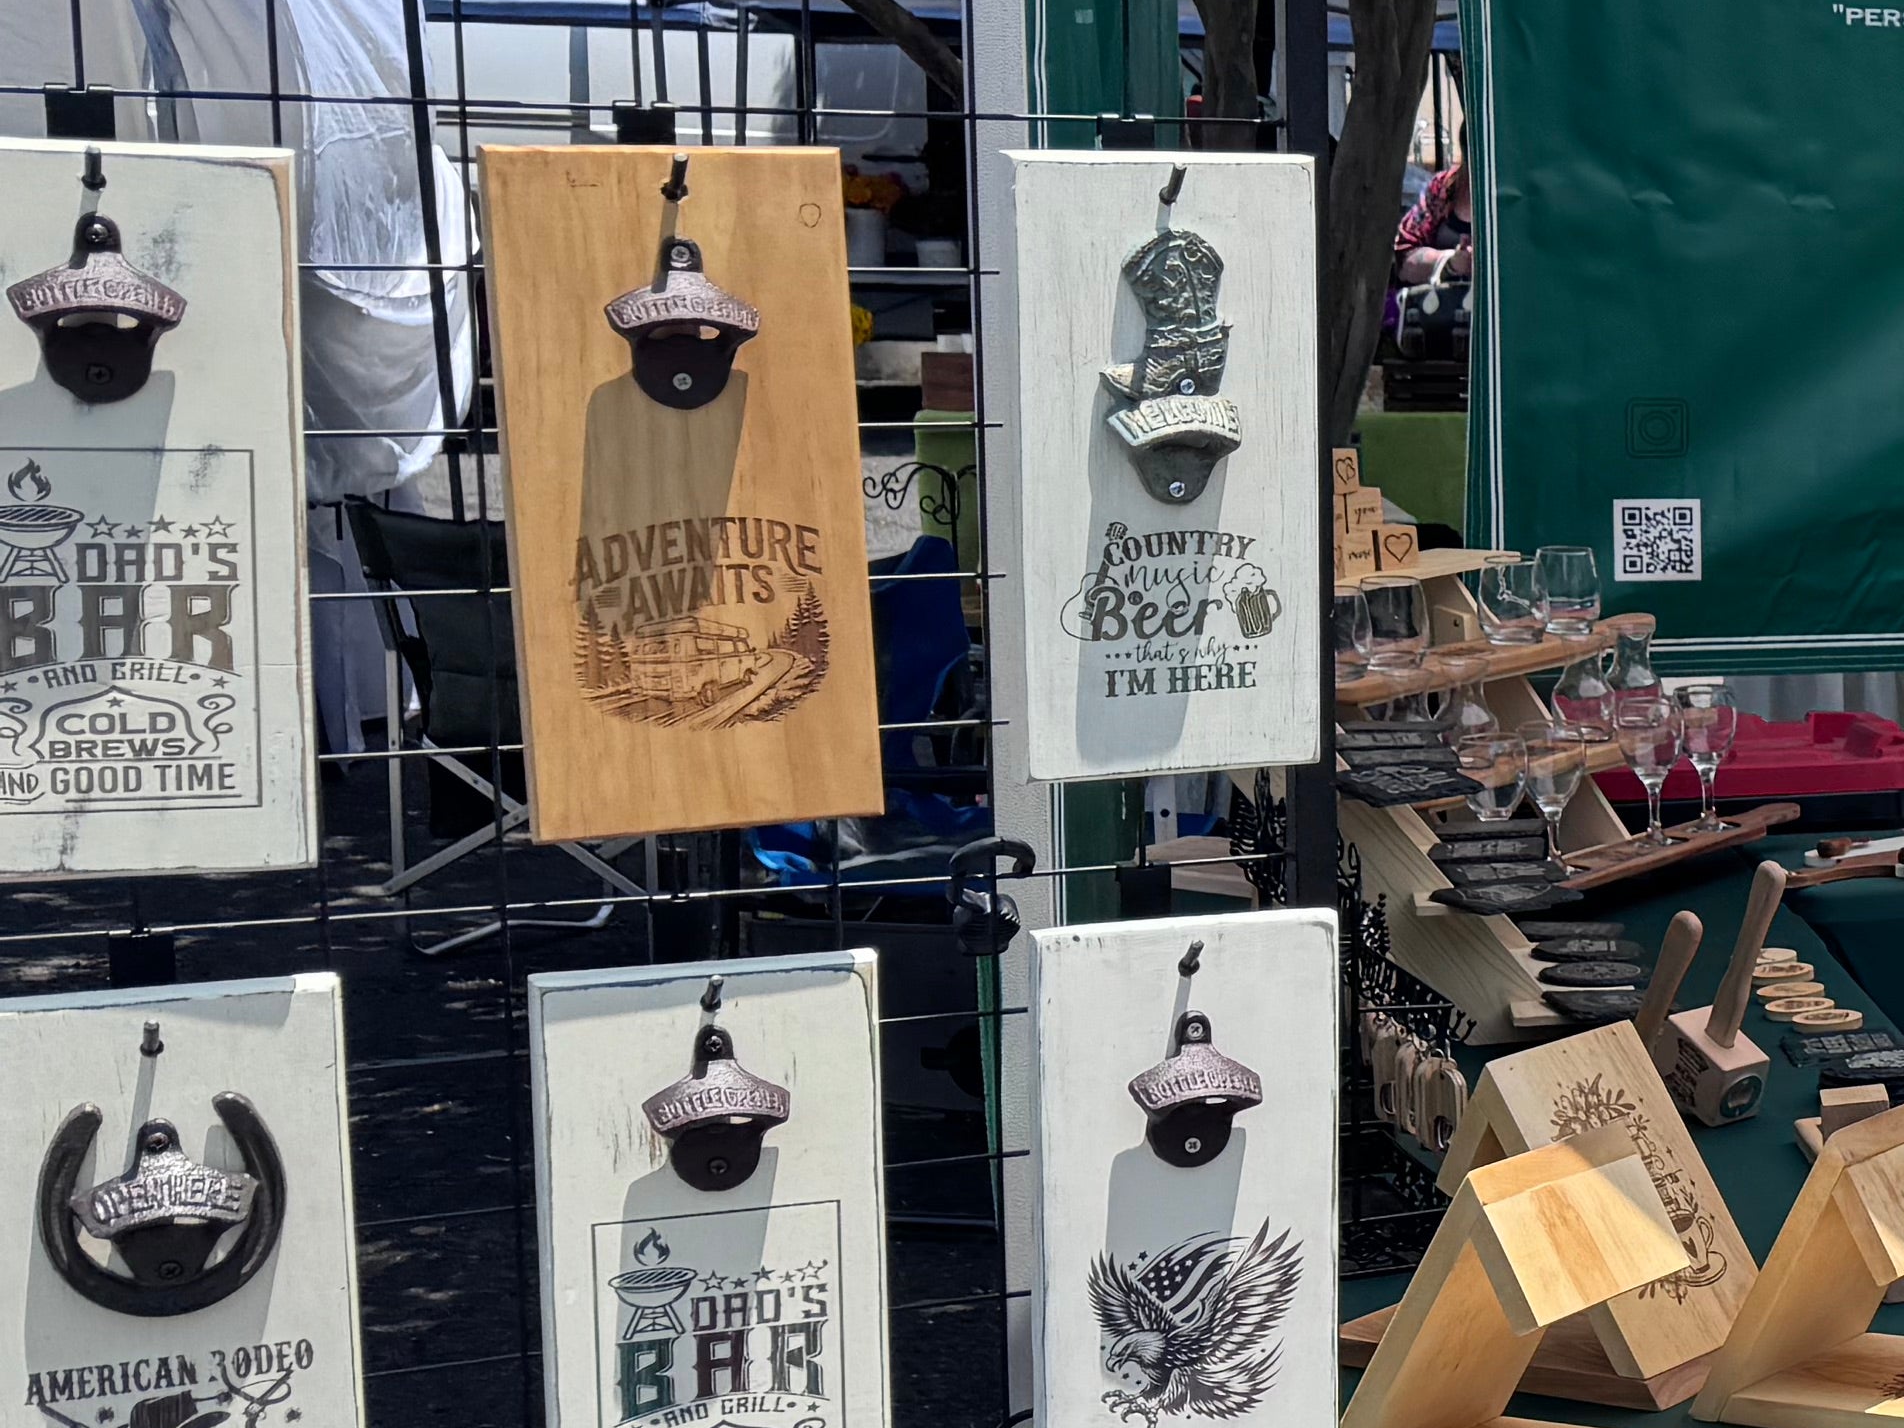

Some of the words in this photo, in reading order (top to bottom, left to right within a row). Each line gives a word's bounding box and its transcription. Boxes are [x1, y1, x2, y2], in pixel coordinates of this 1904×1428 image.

[75, 542, 239, 583] DAD'S
[573, 517, 823, 599] ADVENTURE
[1104, 530, 1256, 566] COUNTRY
[622, 564, 777, 630] AWAITS
[1085, 586, 1223, 641] Beer
[0, 584, 240, 672] BAR
[42, 663, 97, 689] AND
[111, 661, 188, 684] GRILL
[1104, 667, 1157, 698] I'M
[1166, 661, 1257, 694] HERE
[55, 711, 176, 736] COLD
[48, 737, 186, 759] BREWS
[50, 765, 142, 795] GOOD
[153, 762, 236, 792] TIME
[690, 1282, 828, 1332] DAD'S
[26, 1355, 197, 1406] AMERICAN
[615, 1320, 827, 1421] BAR
[663, 1400, 710, 1428] AND
[720, 1393, 785, 1417] GRILL
